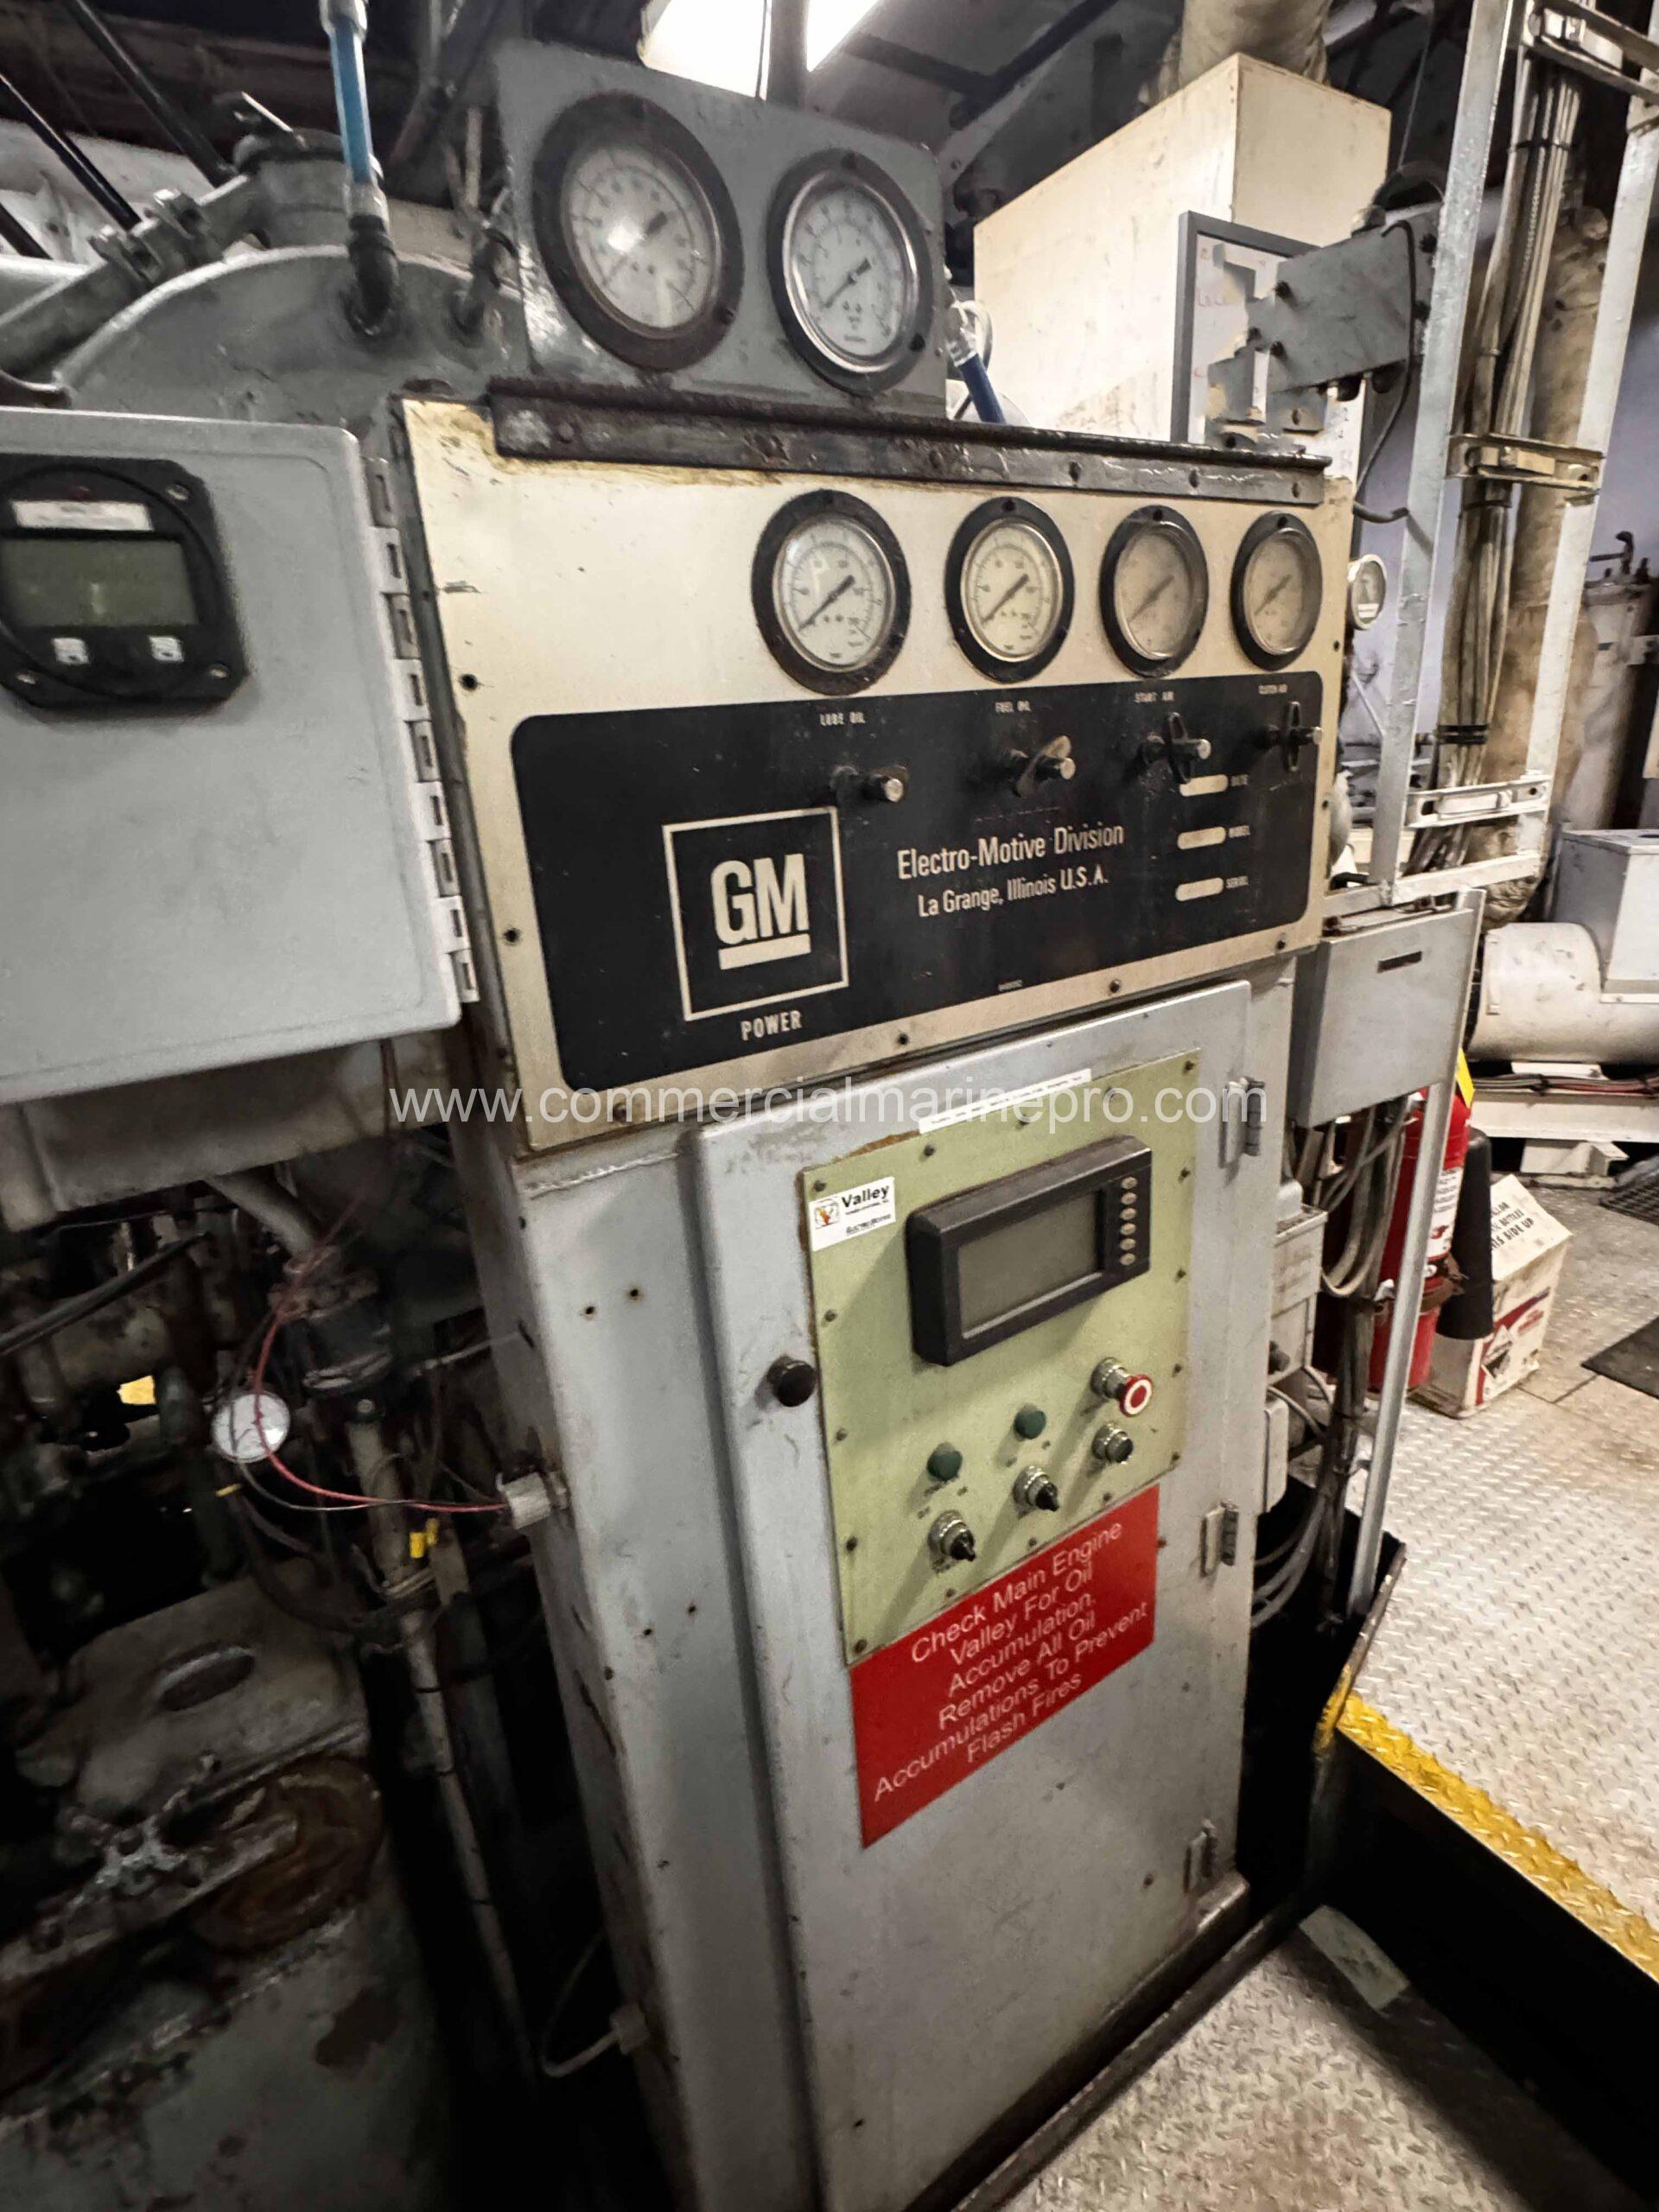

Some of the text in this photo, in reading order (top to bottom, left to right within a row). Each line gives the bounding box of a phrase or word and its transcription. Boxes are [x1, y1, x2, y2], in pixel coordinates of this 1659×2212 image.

[820, 713, 844, 726] LUBE
[897, 821, 1124, 880] Electro-Motive Division
[710, 853, 810, 944] GM
[918, 894, 939, 917] La
[943, 887, 1004, 912] Grange,
[1007, 873, 1056, 900] Illinois
[740, 1009, 803, 1040] POWER
[842, 1185, 890, 1208] Valley
[1503, 1224, 1524, 1241] SIDE
[1521, 1217, 1534, 1229] UP
[912, 1522, 1122, 1663] Check Main Engine
[950, 1560, 1093, 1665] Valley For Oil
[874, 1601, 1147, 1802] Accumulations To Prevent
[938, 1611, 1095, 1729] Remove All Oil
[967, 1673, 1082, 1763] Flash Fires
